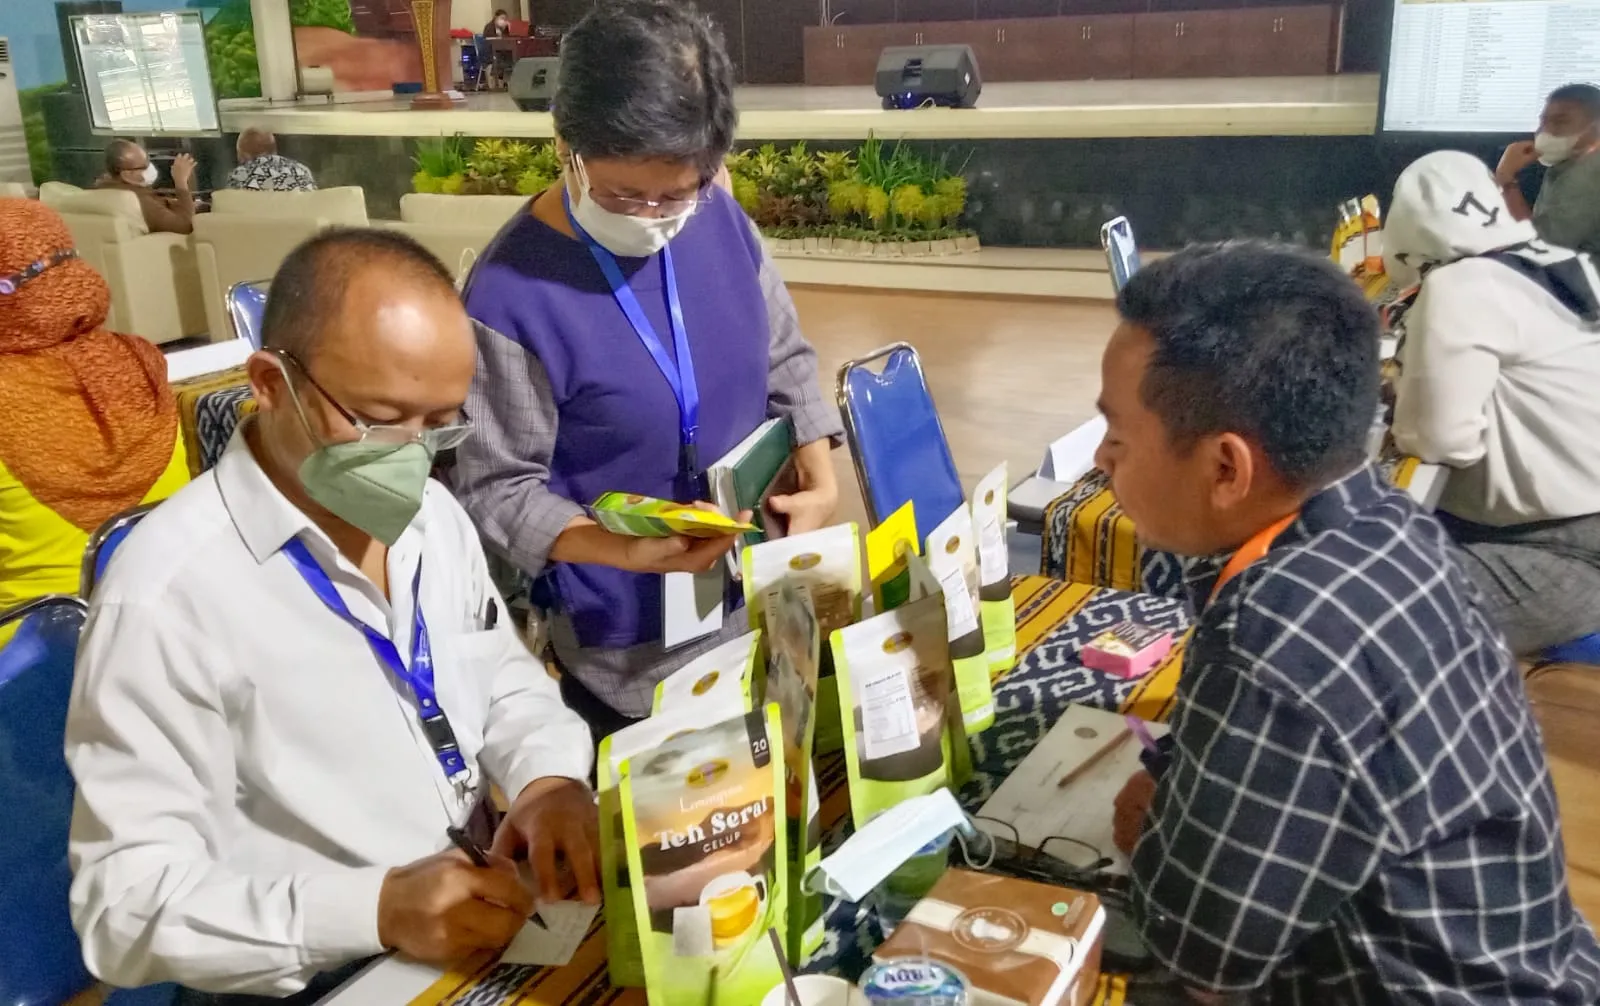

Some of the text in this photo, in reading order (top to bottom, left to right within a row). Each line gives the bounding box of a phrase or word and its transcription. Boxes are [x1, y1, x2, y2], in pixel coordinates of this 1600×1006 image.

[753, 738, 767, 754] 20
[654, 823, 706, 851] Teh
[702, 831, 741, 853] CELUP
